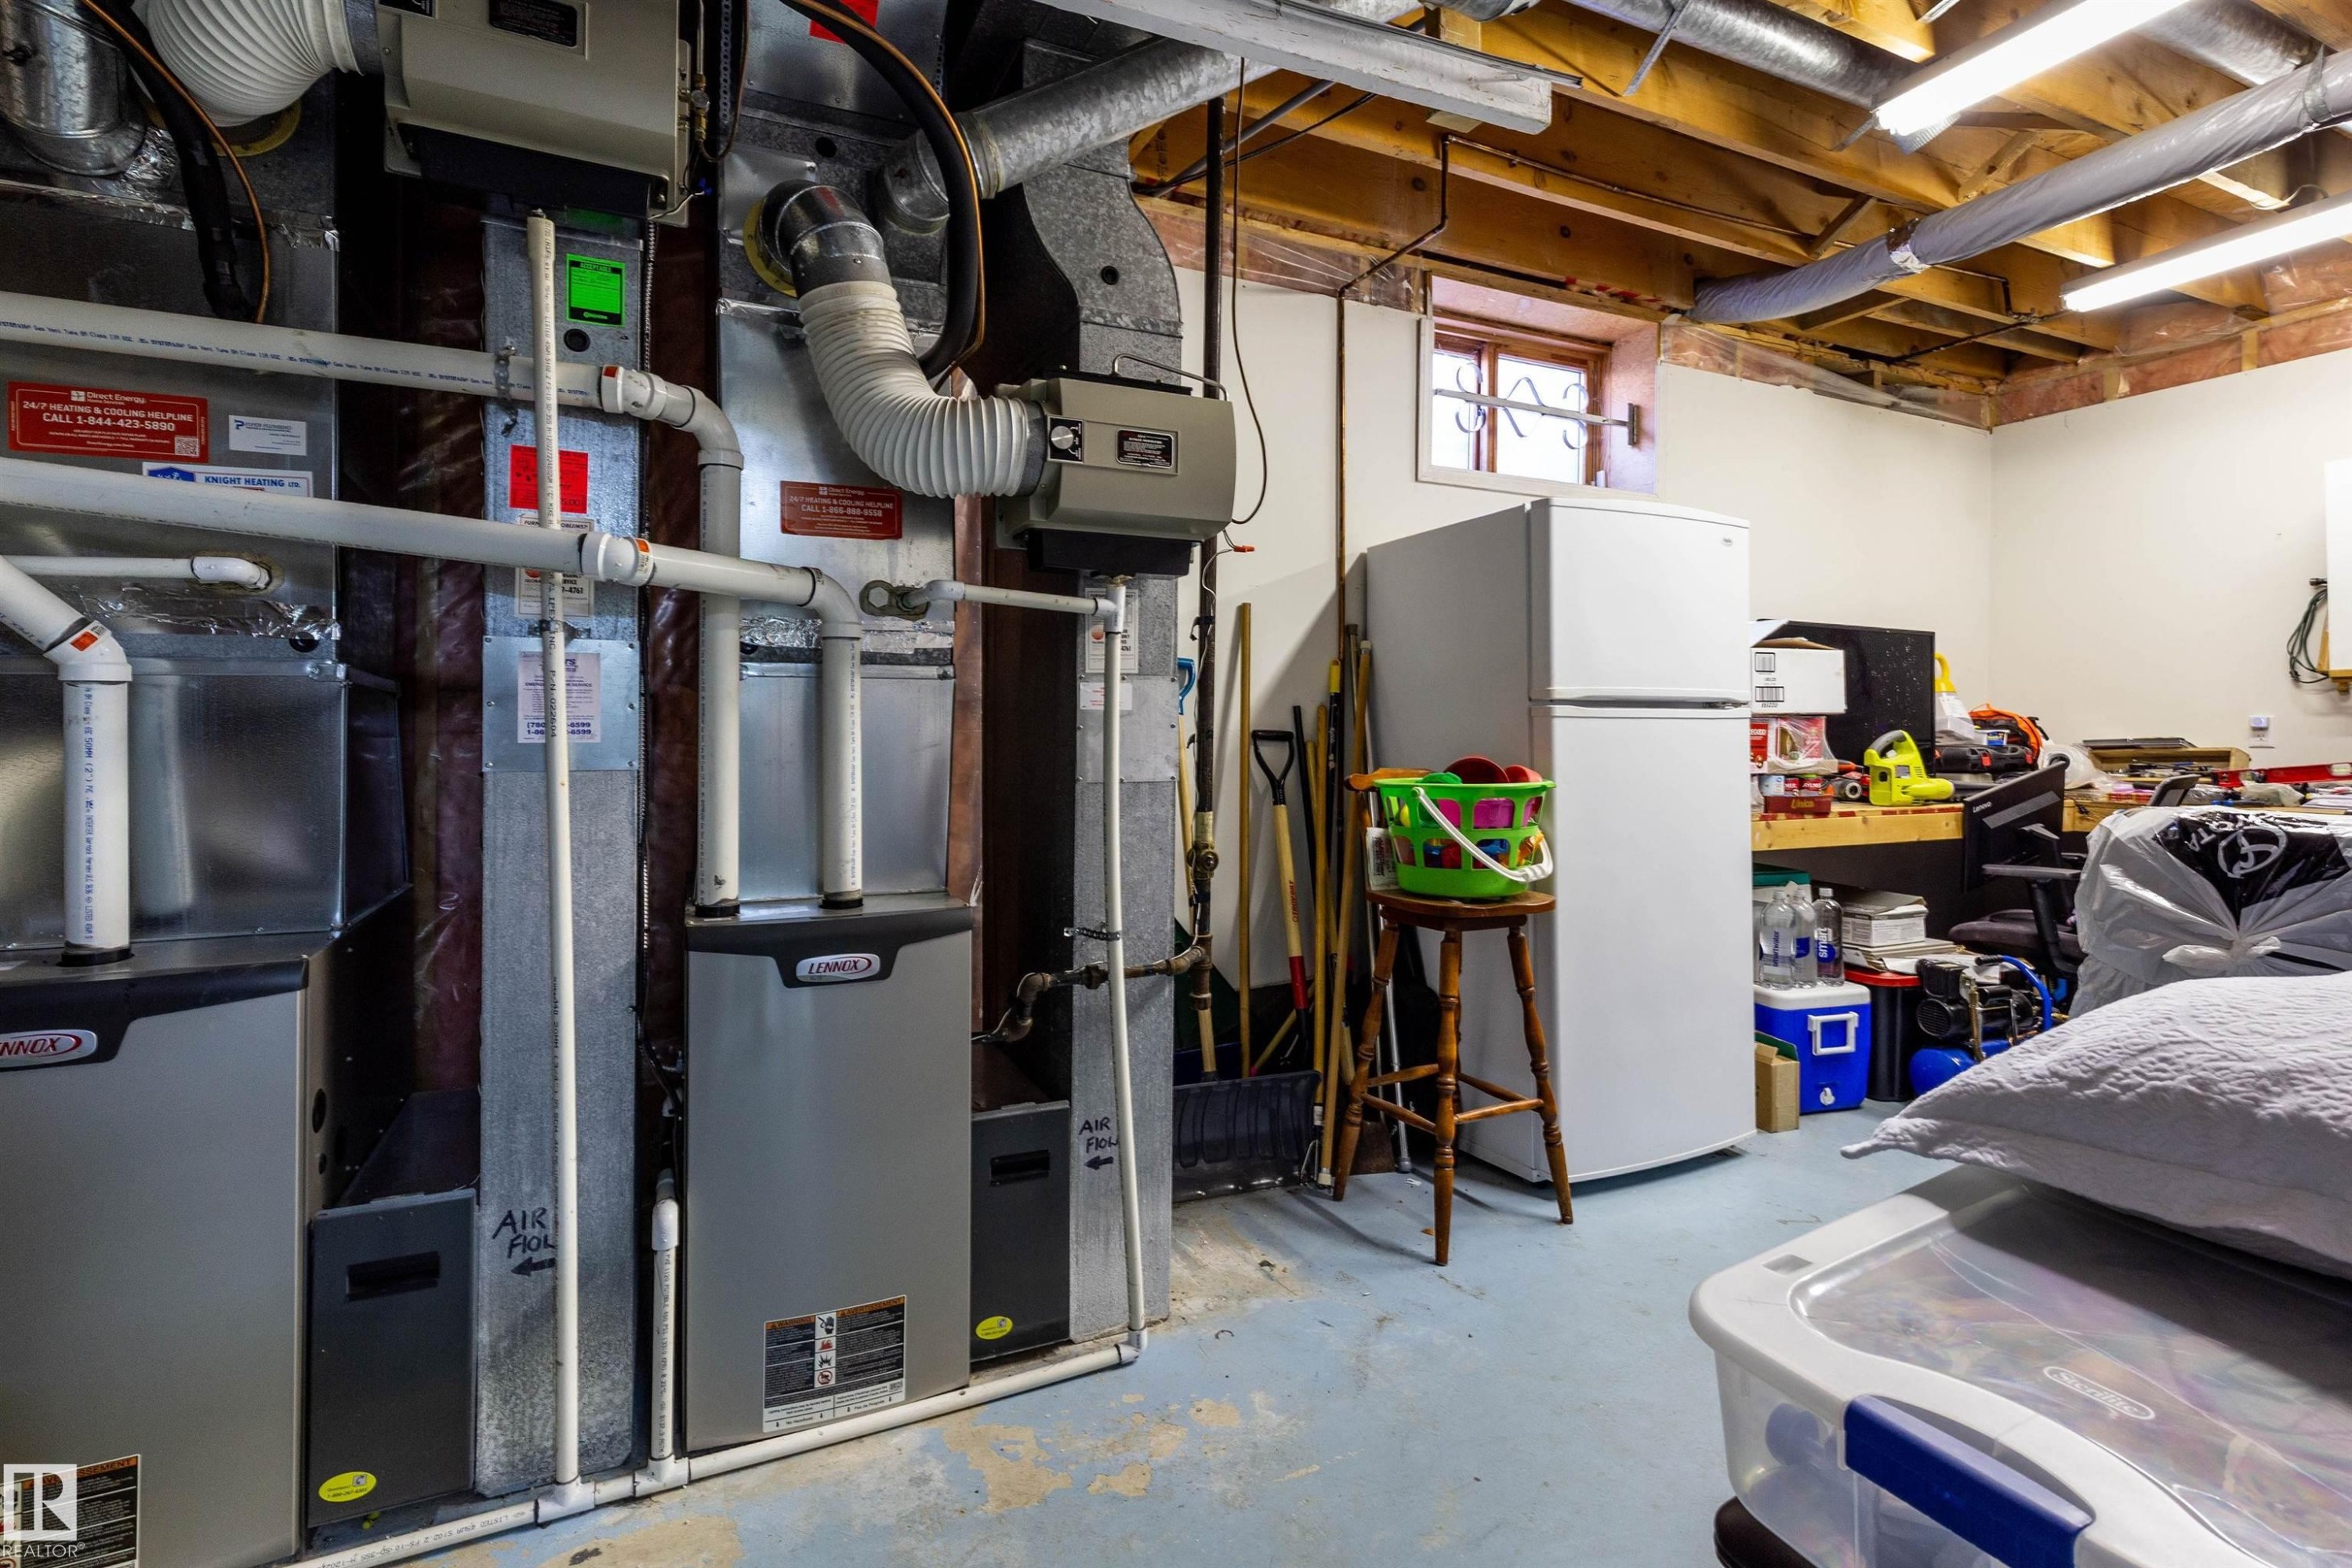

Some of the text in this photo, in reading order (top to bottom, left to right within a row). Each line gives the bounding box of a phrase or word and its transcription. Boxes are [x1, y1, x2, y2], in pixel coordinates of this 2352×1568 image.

[86, 392, 145, 404] Direct Energy
[23, 401, 46, 410] 24/7
[49, 403, 91, 414] HEATING
[103, 408, 146, 418] COOLING
[147, 411, 194, 422] HELPLINE
[42, 412, 175, 431] CALL 1-844-423-5890
[205, 475, 241, 485] KNIGHT
[244, 477, 285, 487] HEATING
[85, 737, 93, 758] 50MM
[1973, 801, 1991, 813] Lenovo
[1817, 927, 1828, 958] smart
[808, 960, 860, 975] LENNOX
[1078, 1116, 1110, 1135] AIR
[492, 1207, 547, 1239] AIR
[847, 1298, 902, 1316] AVERTISSEMENT
[777, 1317, 812, 1327] WARNING
[2053, 1372, 2139, 1414] Sterilite
[479, 1515, 509, 1528] LISTED
